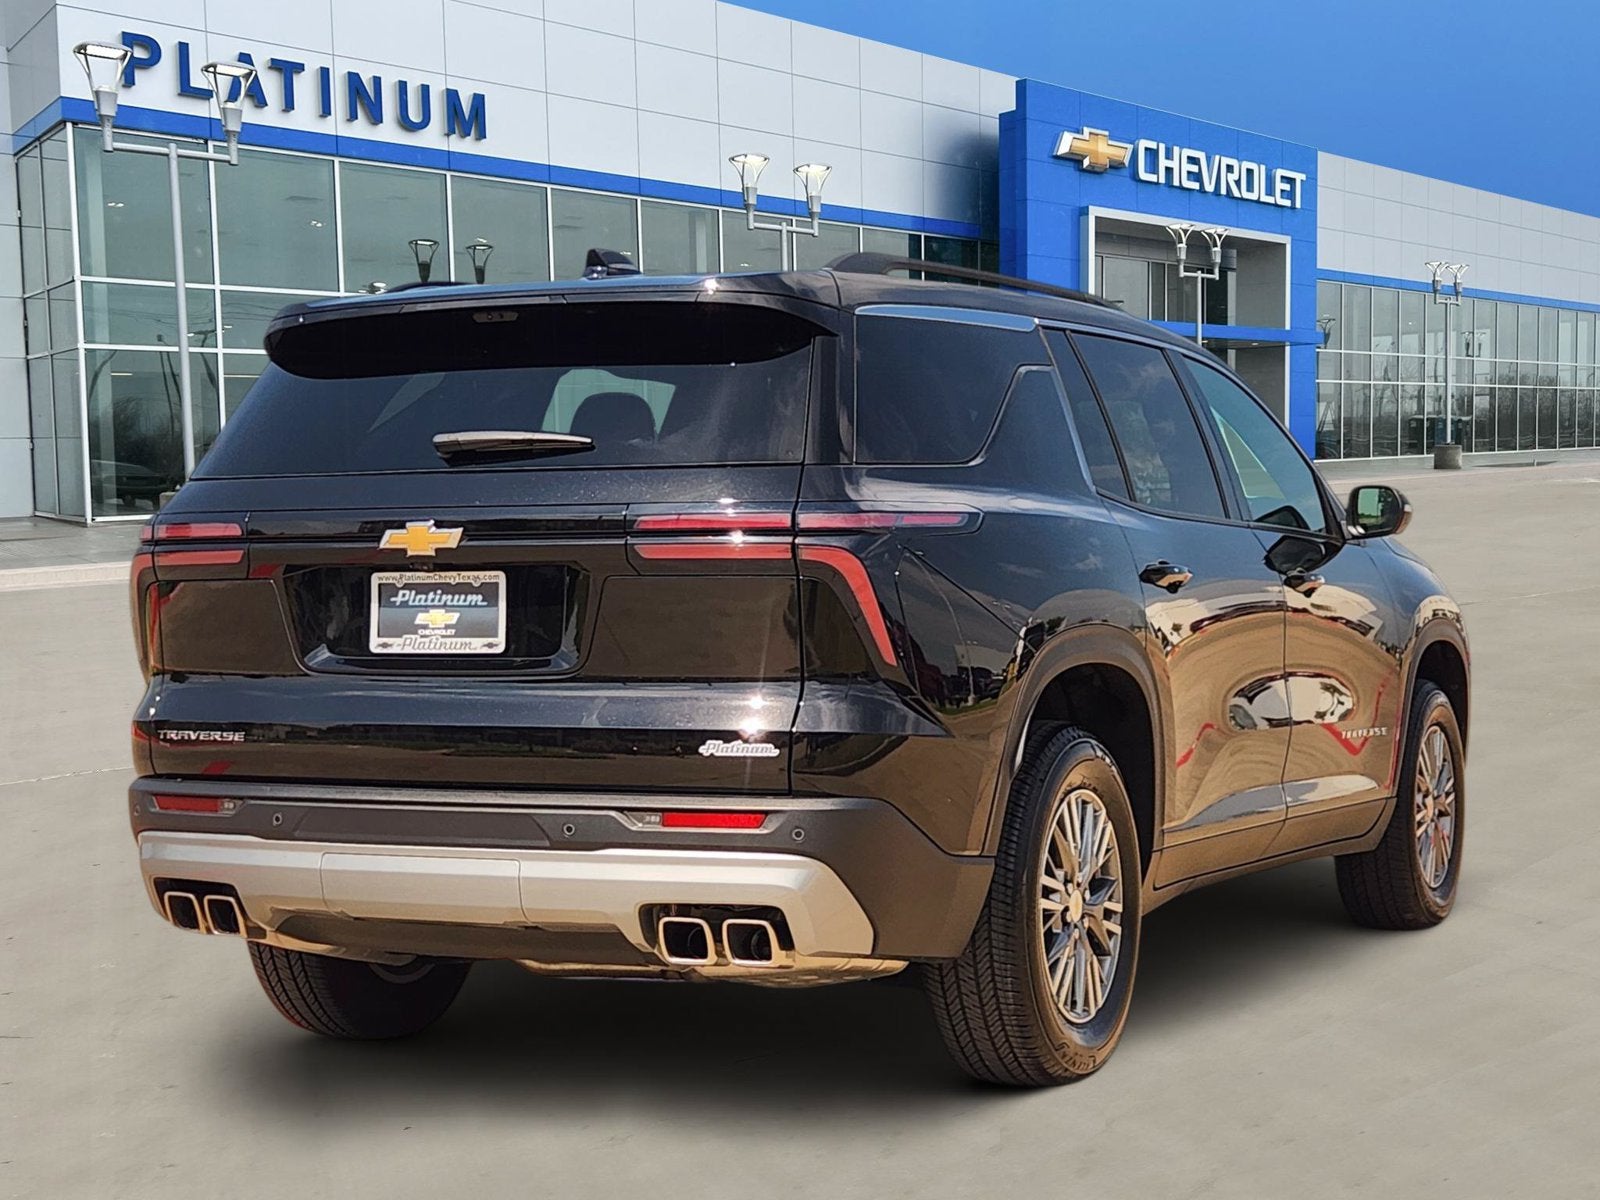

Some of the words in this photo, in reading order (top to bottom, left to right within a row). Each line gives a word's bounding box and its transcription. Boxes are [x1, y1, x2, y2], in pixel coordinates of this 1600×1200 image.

[120, 31, 488, 141] PLATINUM
[1135, 138, 1307, 209] CHEVROLET
[390, 590, 488, 606] Platinum
[397, 635, 478, 652] Platinum
[157, 730, 246, 742] TRAVERSE
[699, 740, 780, 757] Platinum
